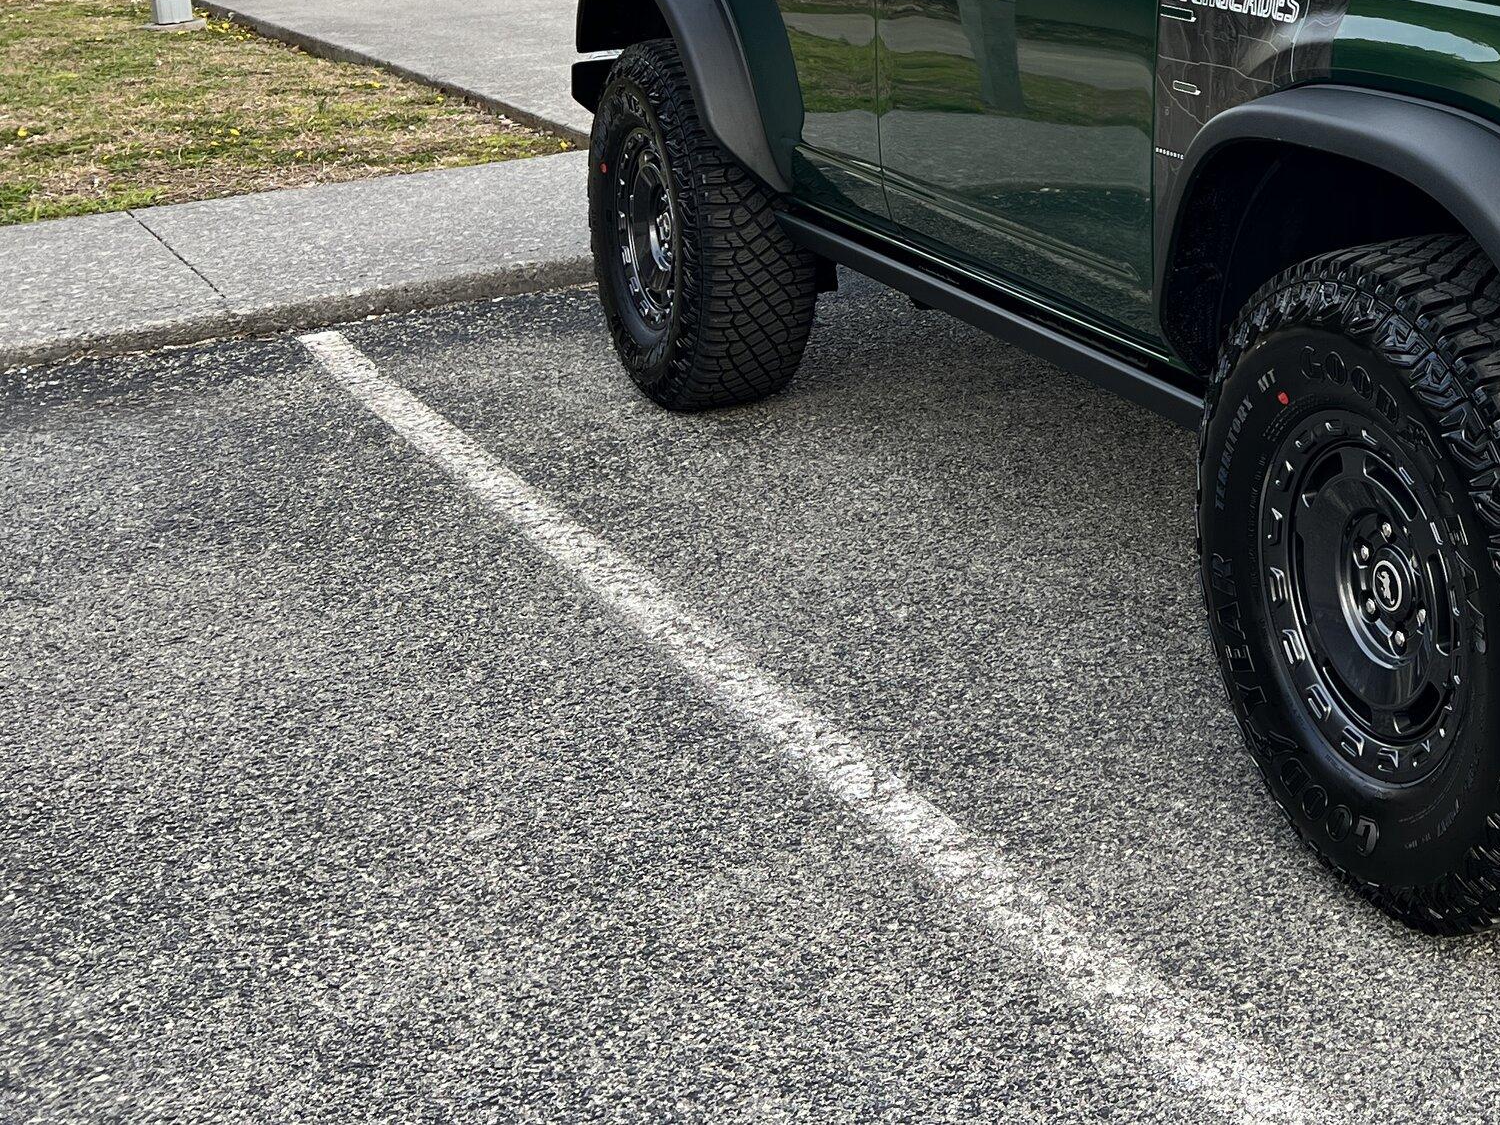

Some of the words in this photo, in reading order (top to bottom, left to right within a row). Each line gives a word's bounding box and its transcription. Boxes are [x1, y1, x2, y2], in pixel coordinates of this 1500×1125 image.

[1214, 393, 1255, 512] TERRITORY
[1256, 367, 1277, 394] MT
[1211, 551, 1380, 858] GOODYEAR
